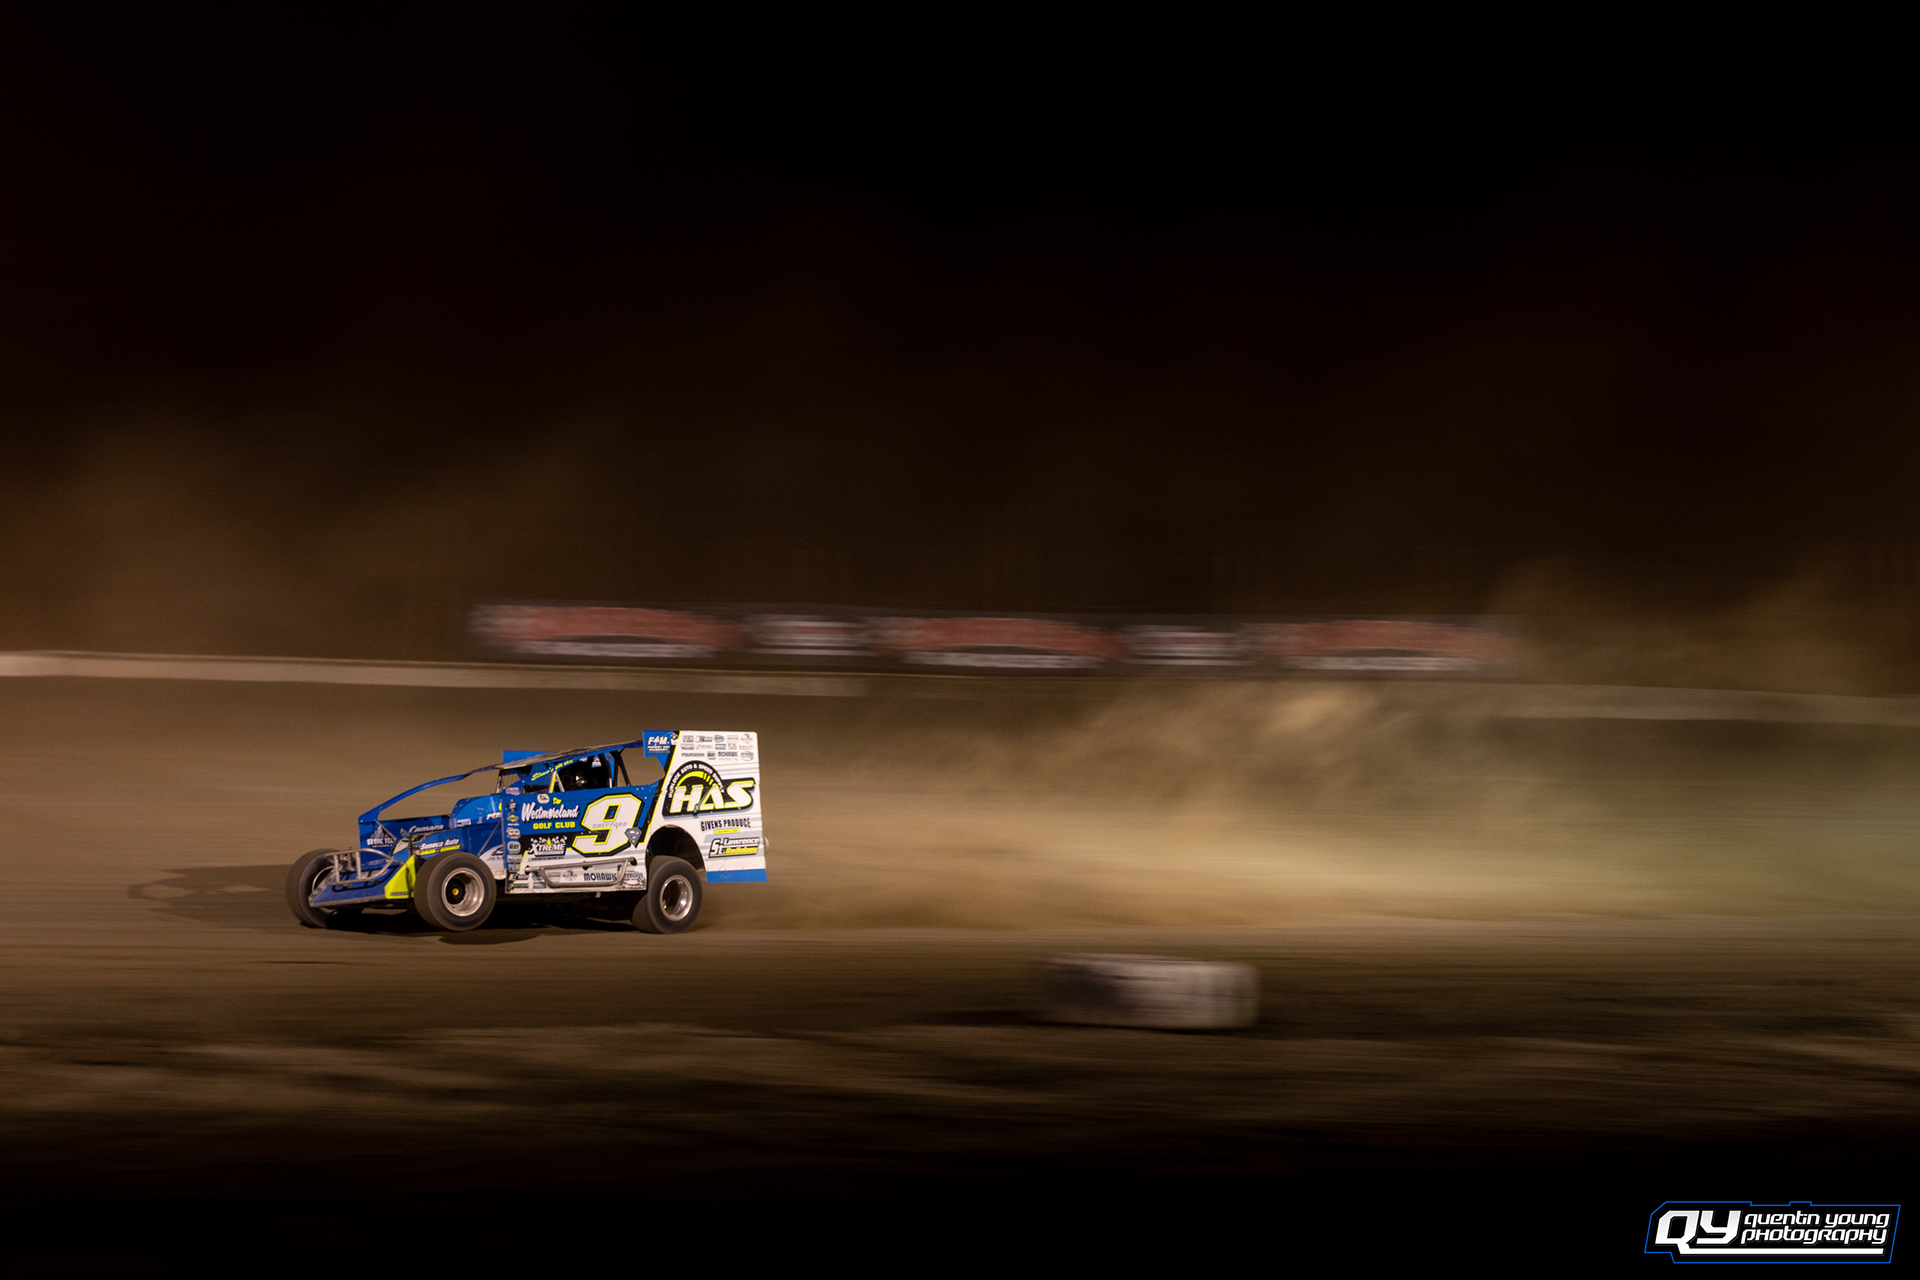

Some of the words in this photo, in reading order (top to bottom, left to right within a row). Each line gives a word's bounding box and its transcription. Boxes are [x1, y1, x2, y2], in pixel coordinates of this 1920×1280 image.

[669, 781, 755, 813] HAS
[521, 802, 579, 821] Westmoreland
[533, 822, 552, 830] GOLF
[555, 821, 576, 829] CLUB
[572, 793, 642, 854] 9
[700, 819, 723, 831] GIVENS
[723, 817, 751, 828] PRODUCE
[583, 872, 617, 881] MOHAWK
